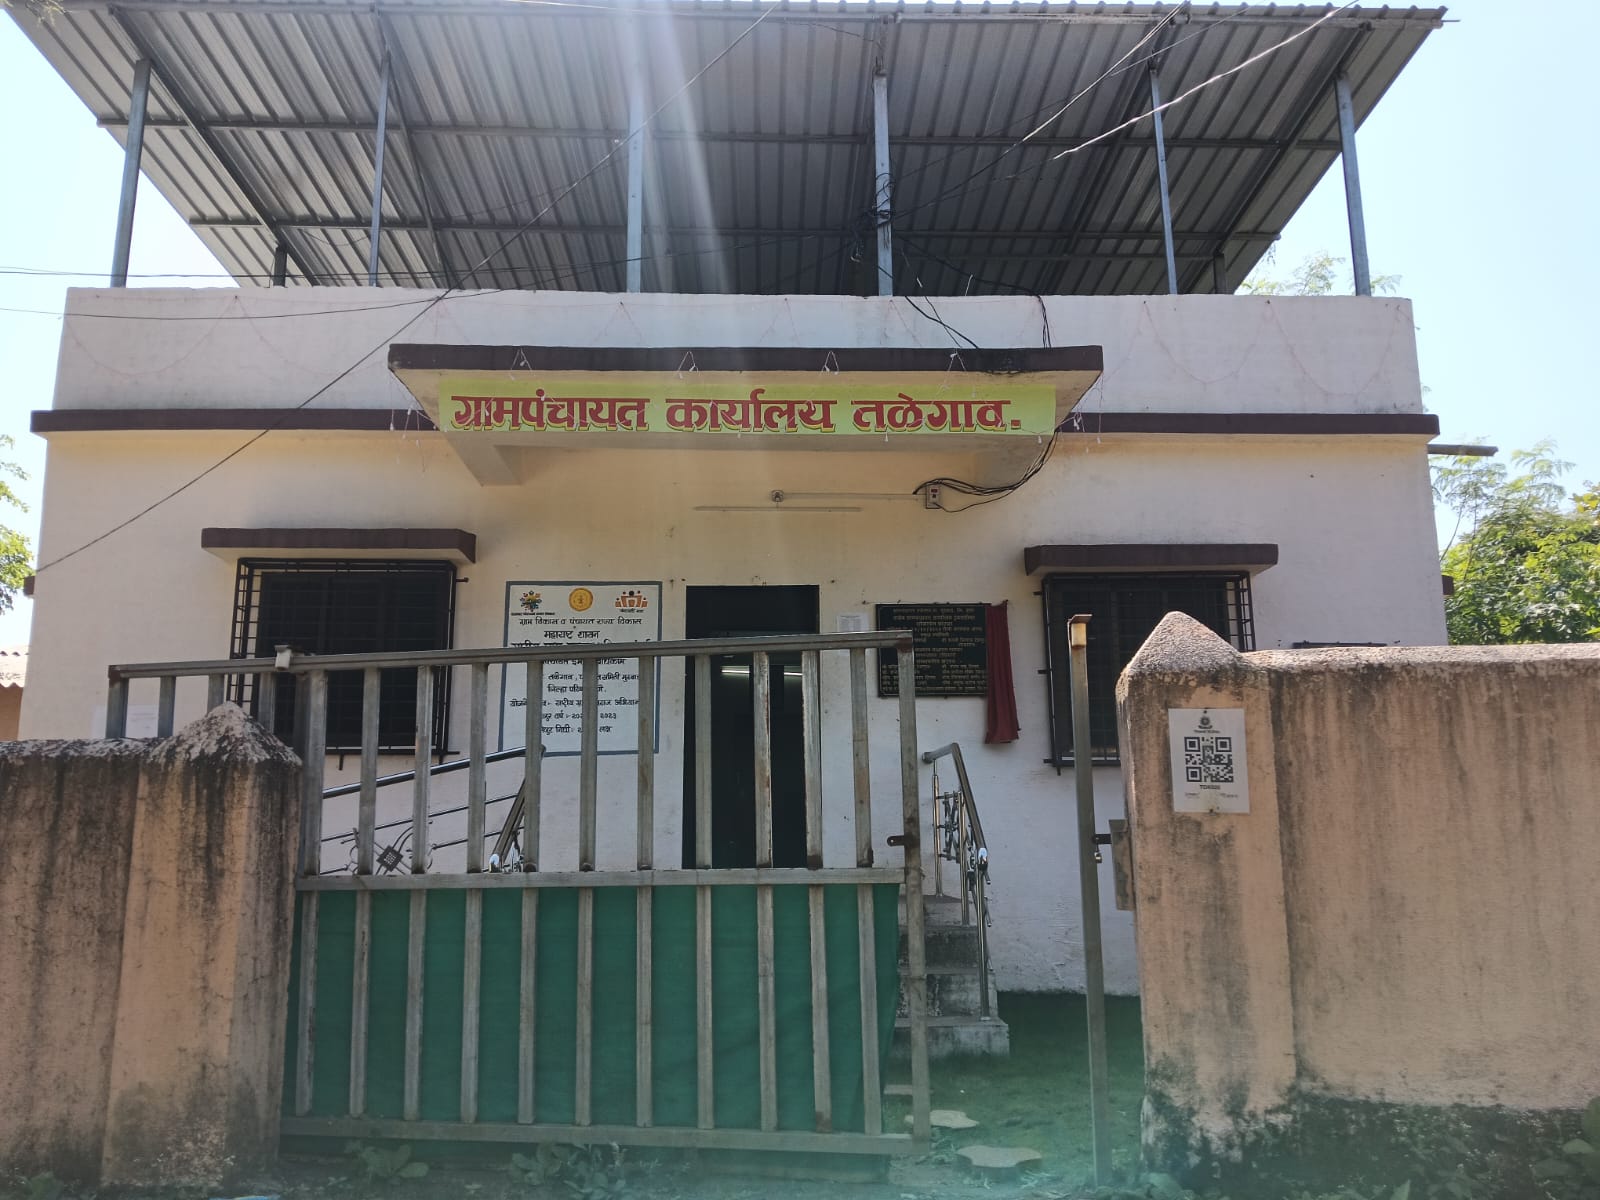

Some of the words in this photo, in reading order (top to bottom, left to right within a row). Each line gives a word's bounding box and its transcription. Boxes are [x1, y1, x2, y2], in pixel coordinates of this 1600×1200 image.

[450, 388, 651, 431] ग्रामपंचायत
[664, 388, 838, 431] कार्यालय
[850, 391, 1021, 431] तळेगाव.
[535, 616, 559, 625] विकास
[568, 616, 595, 625] पंचायत
